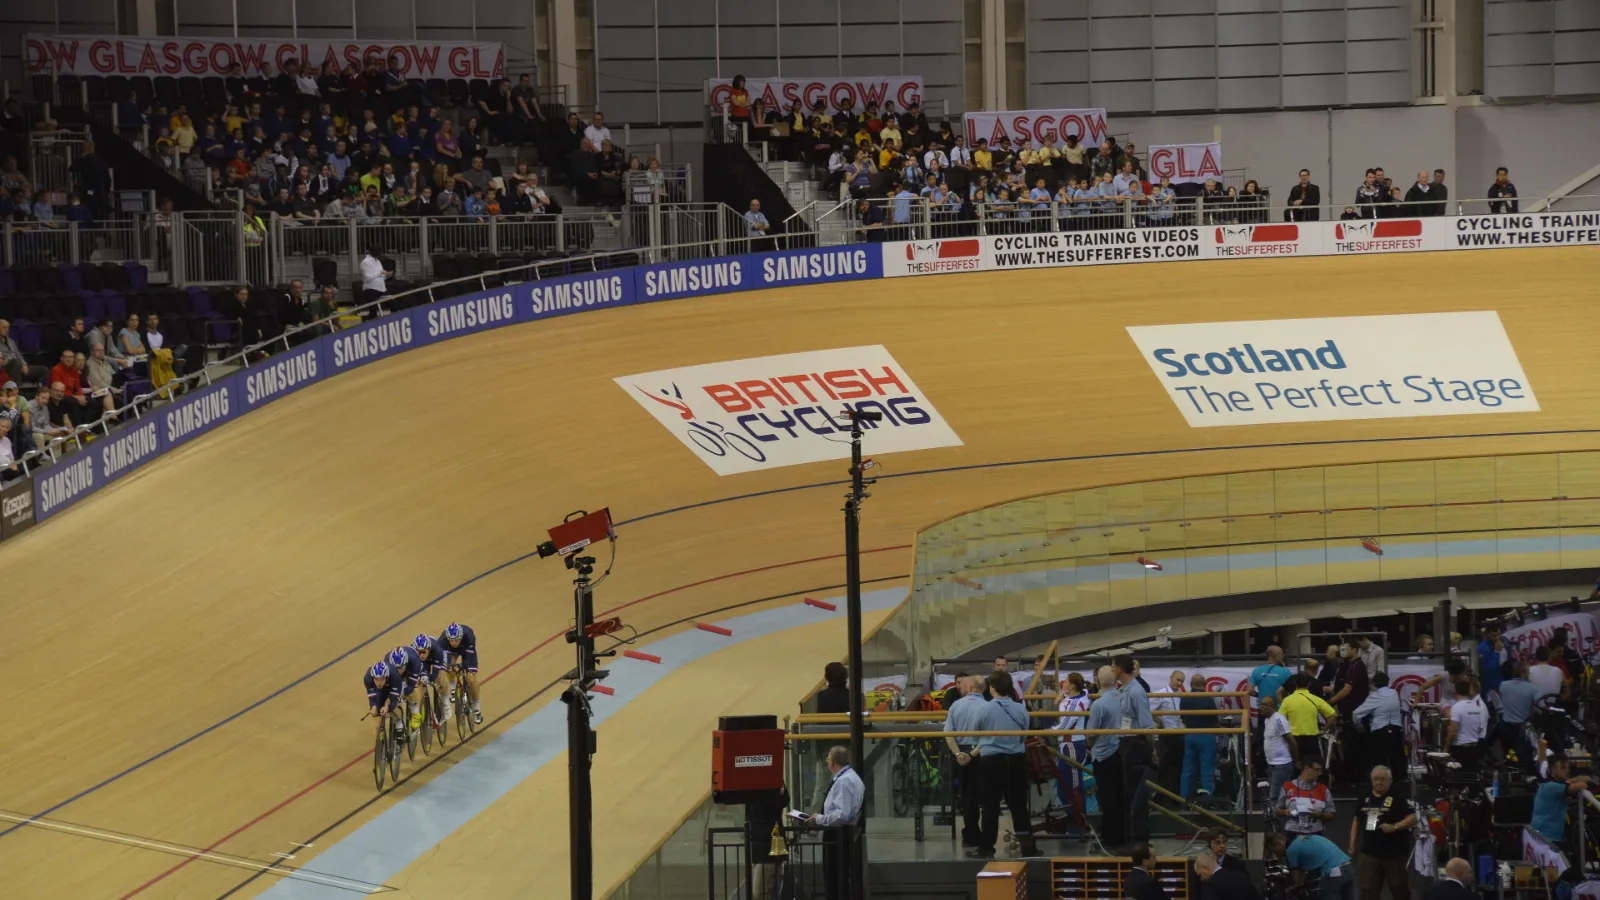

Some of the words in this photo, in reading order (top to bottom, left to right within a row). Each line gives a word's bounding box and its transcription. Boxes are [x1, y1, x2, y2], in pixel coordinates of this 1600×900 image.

[89, 41, 267, 75] GLASGOW
[711, 82, 888, 113] GASGOW
[1150, 146, 1222, 178] GLA
[994, 234, 1058, 250] CYCLING
[1064, 231, 1137, 247] TRAINING
[1142, 228, 1199, 243] VIDEOS
[1456, 216, 1534, 231] CYCLING
[1457, 229, 1600, 246] WWW.THESUFFE
[995, 244, 1199, 267] WWW.THESUFFERFEST.COM
[1215, 243, 1299, 256] THESUFFERFEST
[1336, 239, 1422, 252] THESUFFERFEST
[645, 261, 742, 296] SAMSUNG
[763, 250, 866, 283] SAMSUNG
[907, 258, 980, 273] THESUFFERFEST
[532, 276, 622, 314] SAMSUNG
[428, 293, 513, 337] SAMSUNG
[333, 317, 412, 367] SAMSUNG
[1153, 339, 1347, 378] Scotland
[246, 350, 316, 404] SAMSUNG
[702, 366, 910, 413] BRITISH
[1175, 385, 1255, 414] The
[1255, 378, 1401, 410] Perfect
[1402, 375, 1526, 406] Stage
[167, 387, 229, 442] SAMSUNG
[103, 422, 156, 477] SAMSUNG
[41, 456, 93, 512] SAMSUNG
[746, 755, 772, 763] TISSOT
